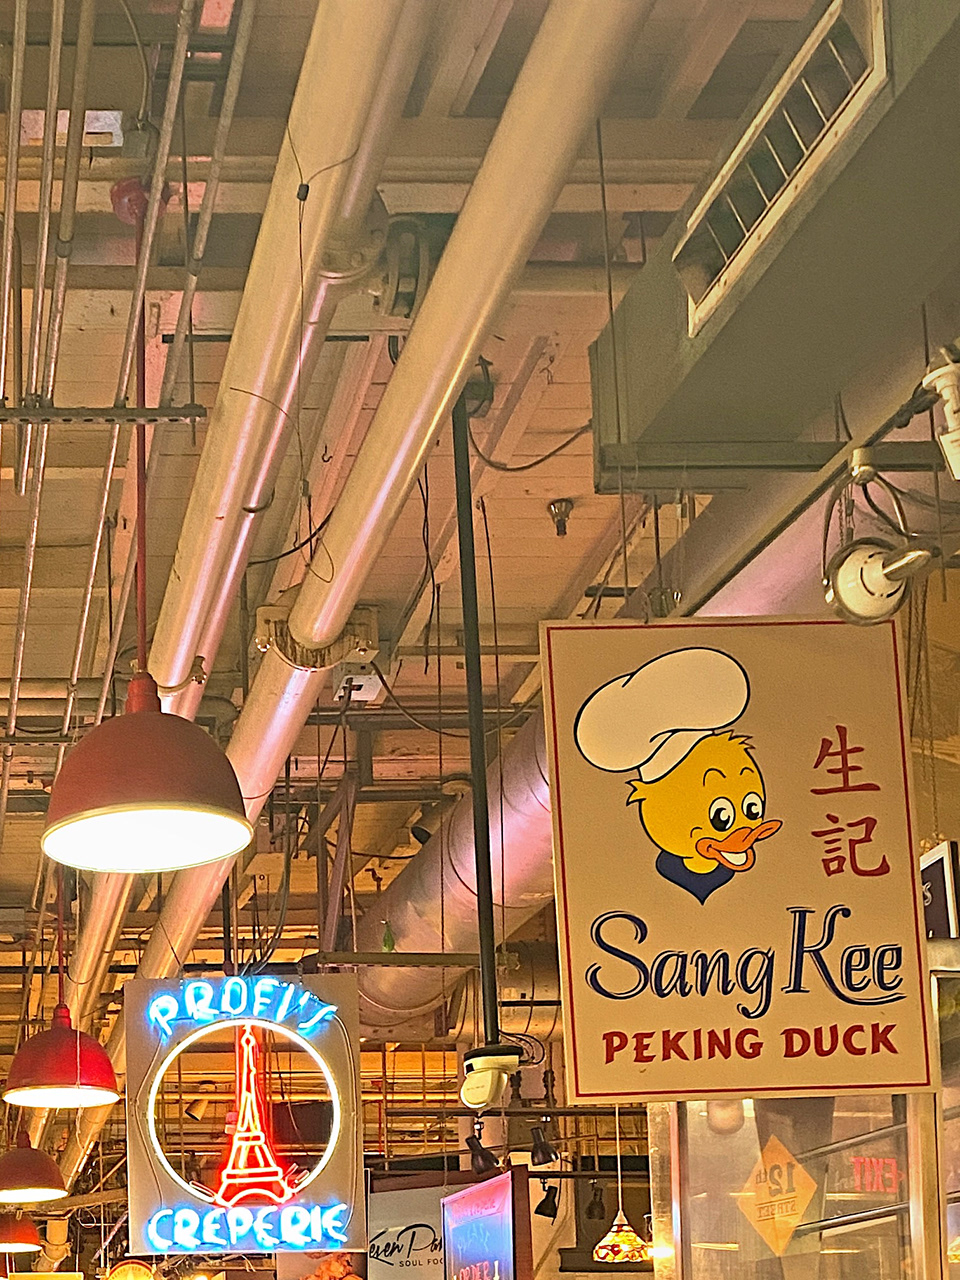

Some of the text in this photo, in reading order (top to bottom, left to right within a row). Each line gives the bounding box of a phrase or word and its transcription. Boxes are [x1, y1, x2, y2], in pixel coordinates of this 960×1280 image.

[809, 724, 891, 879] 生記
[585, 904, 907, 1020] Sang Kee
[602, 1022, 900, 1065] PEKING DUCK
[147, 1203, 348, 1247] CREPERIE
[399, 1258, 443, 1268] SOUL FO
